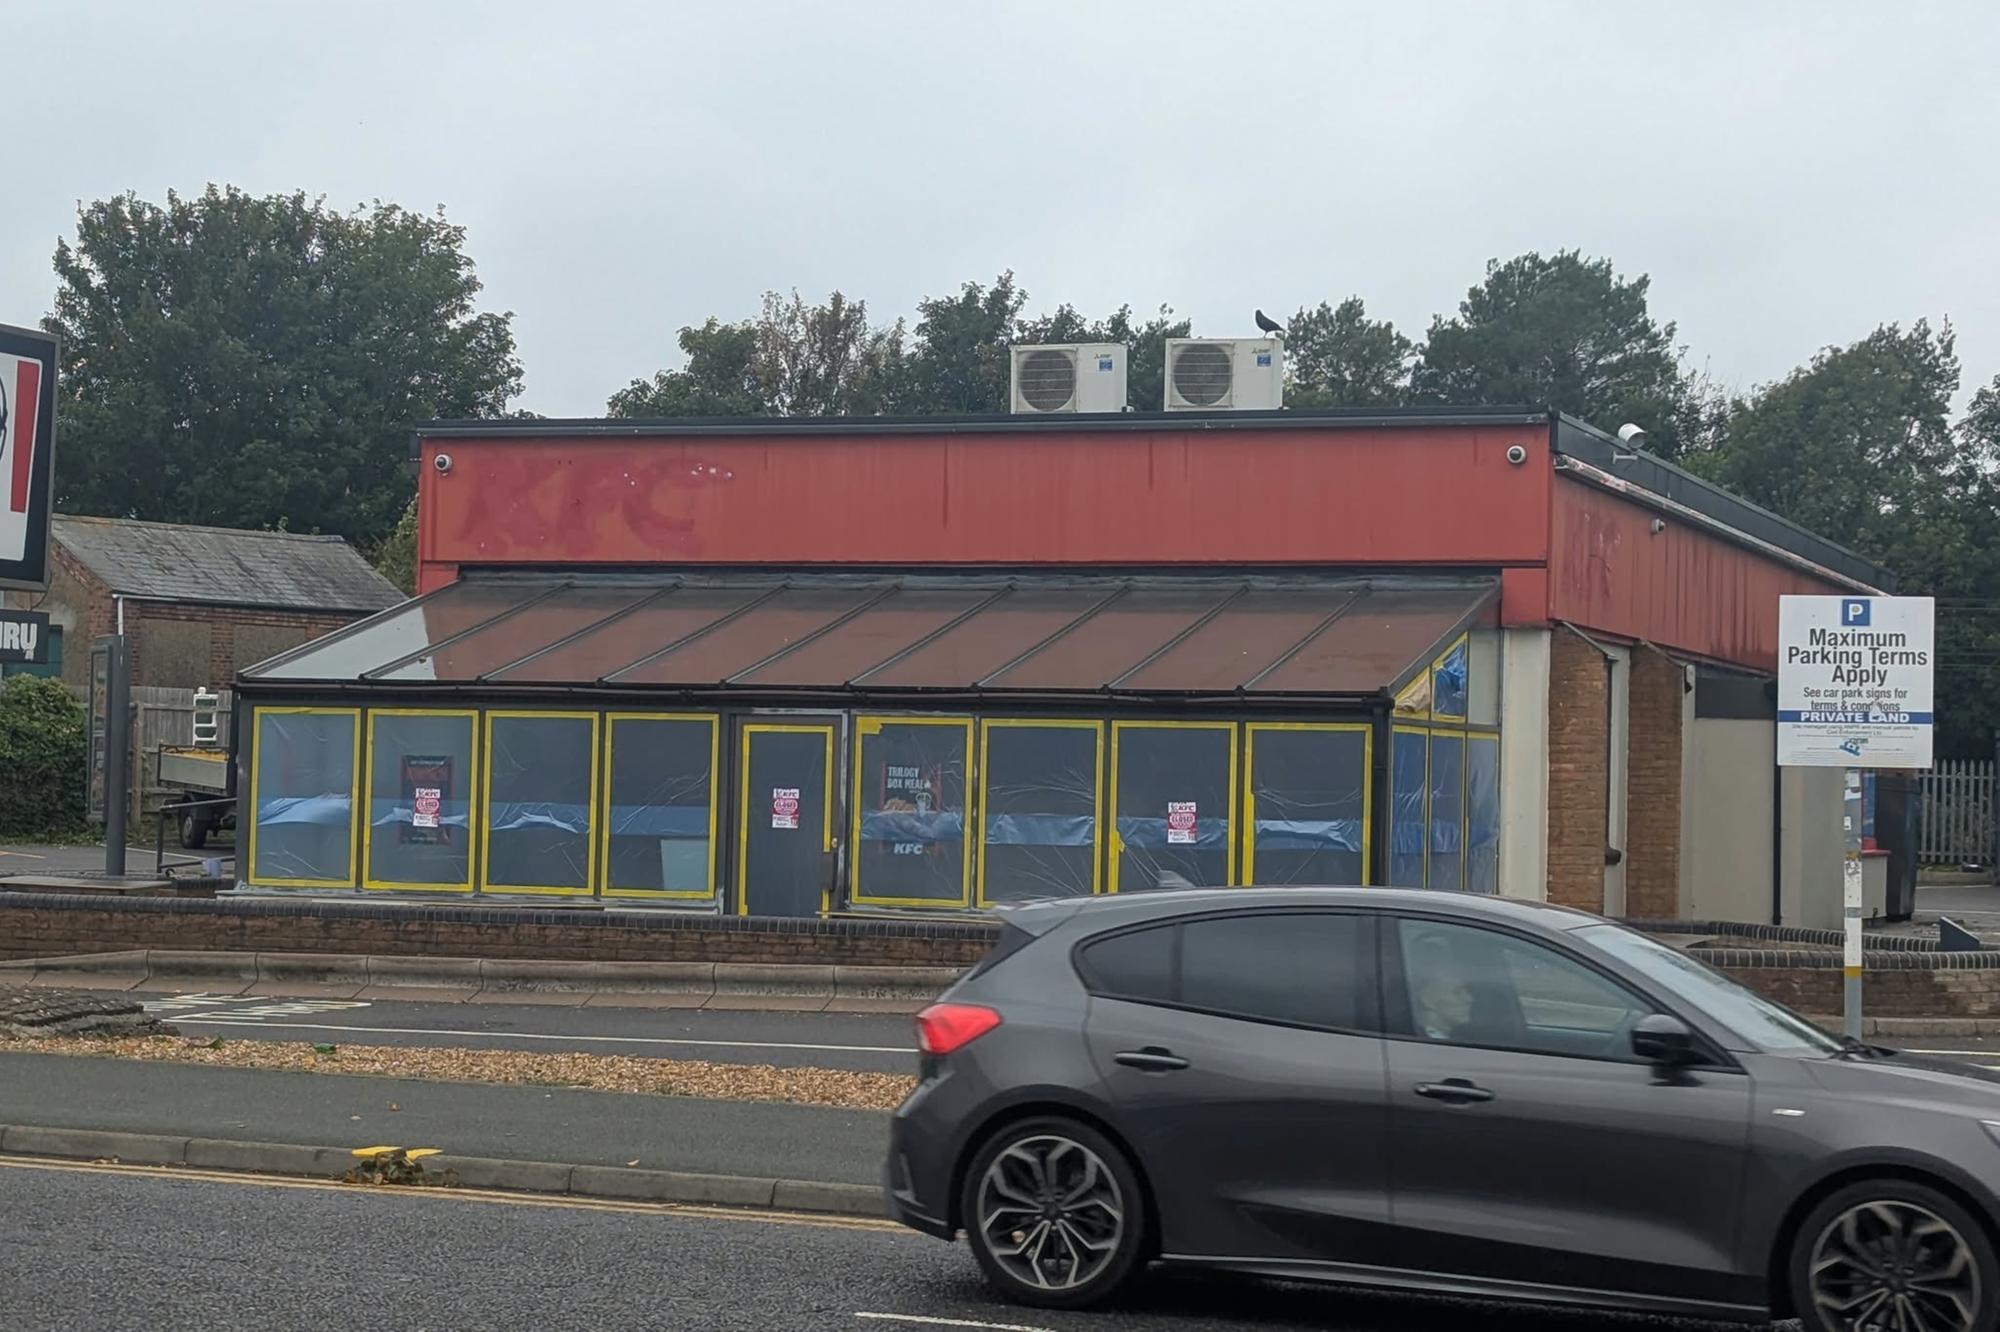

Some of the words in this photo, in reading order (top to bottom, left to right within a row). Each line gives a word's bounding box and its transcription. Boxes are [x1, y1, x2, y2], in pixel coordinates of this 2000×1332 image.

[1848, 603, 1864, 622] P
[0, 621, 38, 660] RU
[1809, 628, 1906, 647] Maximum
[1788, 646, 1862, 668] Parking
[1868, 648, 1928, 665] Terms
[1831, 664, 1888, 687] Apply
[1803, 687, 1820, 698] See
[1823, 689, 1839, 698] car
[1842, 687, 1863, 700] park
[1866, 688, 1892, 701] signs
[1894, 688, 1908, 698] for
[1811, 701, 1838, 711] terms
[1841, 701, 1848, 711] &
[1800, 712, 1865, 723] PRIVATE
[1868, 712, 1910, 723] LAND
[888, 766, 920, 778] TRILOGY
[887, 778, 903, 789] BOX
[904, 778, 924, 790] MEAL
[894, 843, 923, 855] KFC
